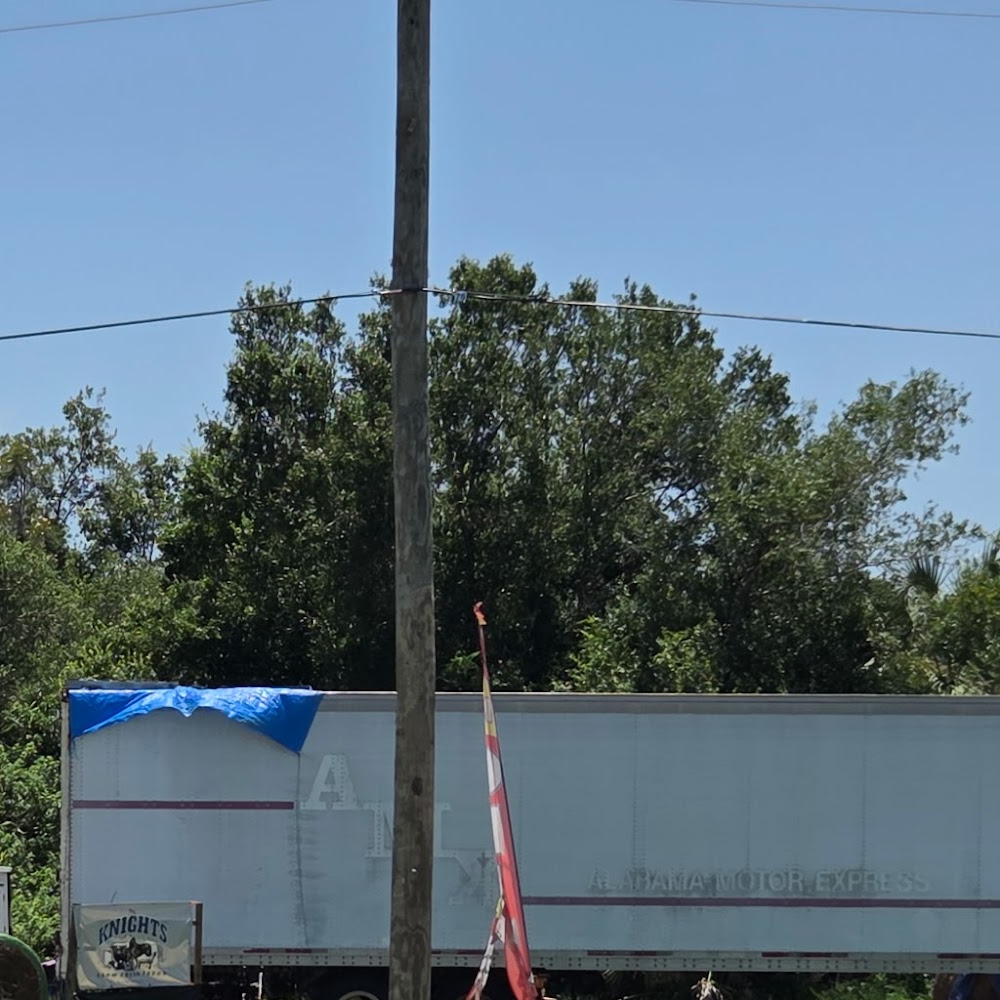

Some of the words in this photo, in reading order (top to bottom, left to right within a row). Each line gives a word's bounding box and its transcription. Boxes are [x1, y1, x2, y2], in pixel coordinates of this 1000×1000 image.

[586, 869, 704, 892] ALABAMA
[716, 870, 804, 893] MOTOR
[815, 870, 932, 893] EXPRESS
[98, 915, 168, 946] KNIGHTS
